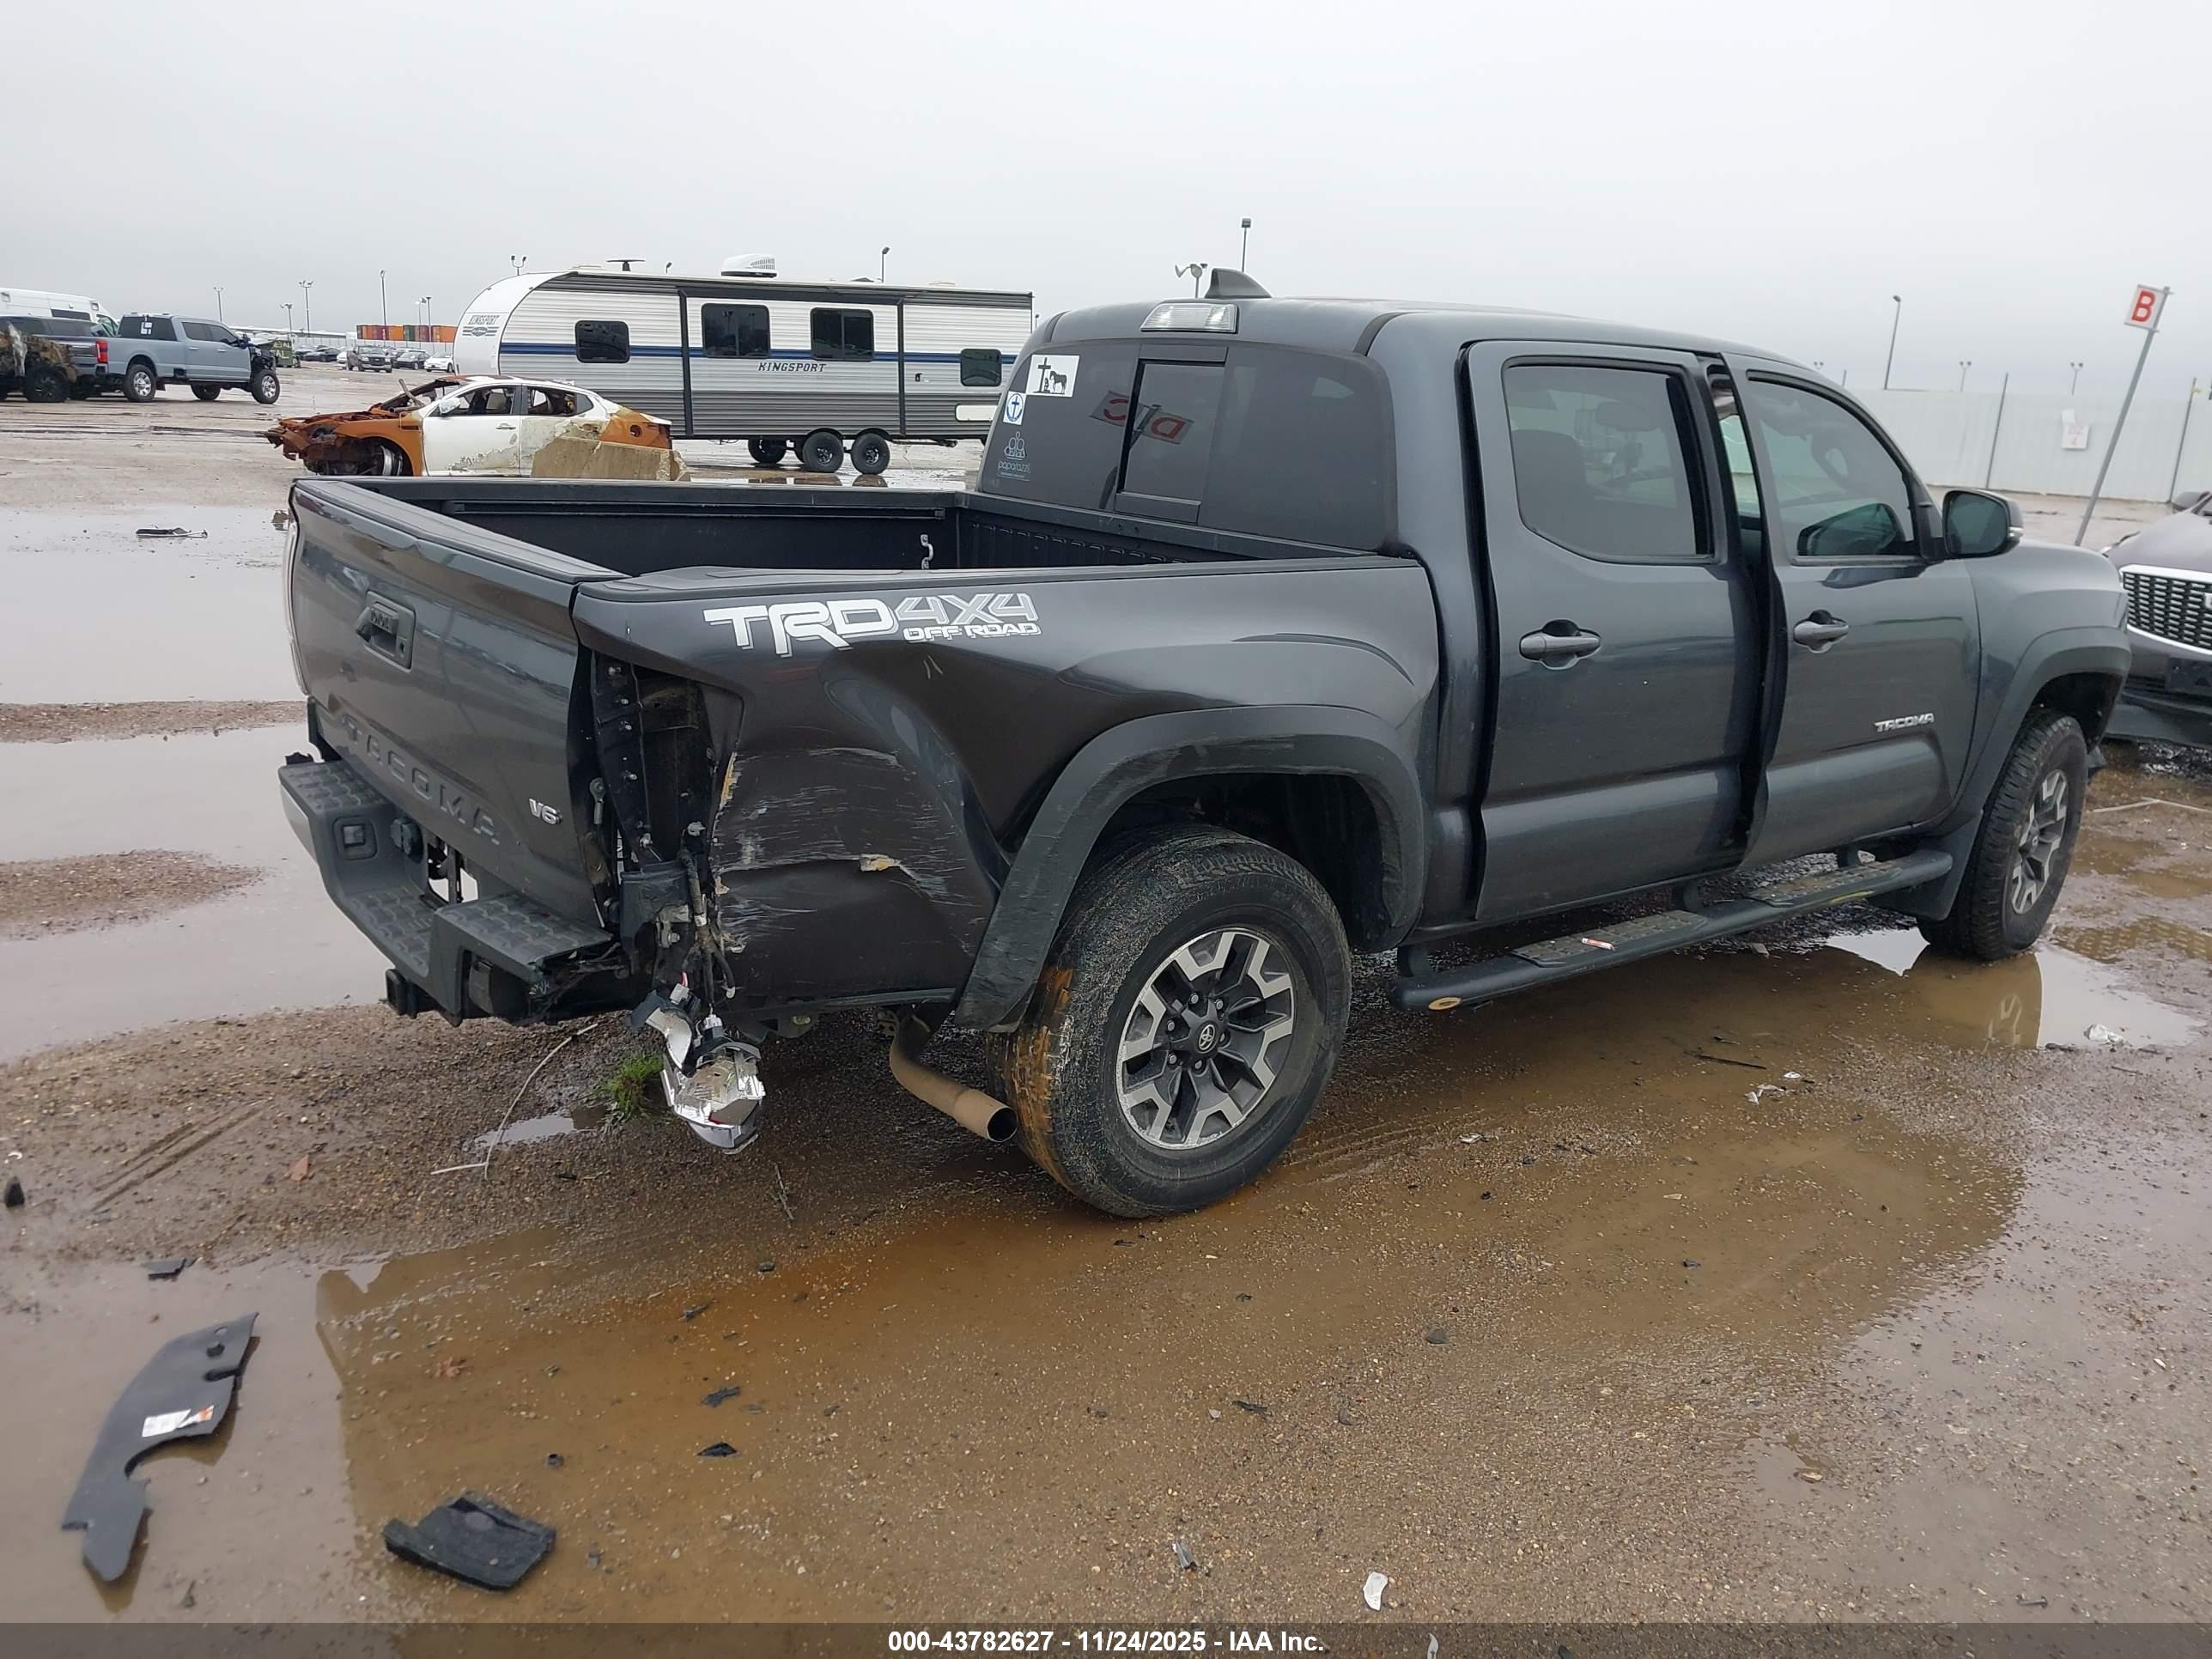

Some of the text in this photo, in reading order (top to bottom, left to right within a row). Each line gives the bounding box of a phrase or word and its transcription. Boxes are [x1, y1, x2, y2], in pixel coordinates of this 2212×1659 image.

[2131, 290, 2156, 323] B
[757, 362, 827, 372] KINGSPORT
[703, 599, 899, 659] TRD
[902, 623, 1042, 643] OFF ROAD
[1874, 713, 1935, 732] TACOMA
[342, 713, 500, 846] TACOMA
[528, 797, 562, 825] V6
